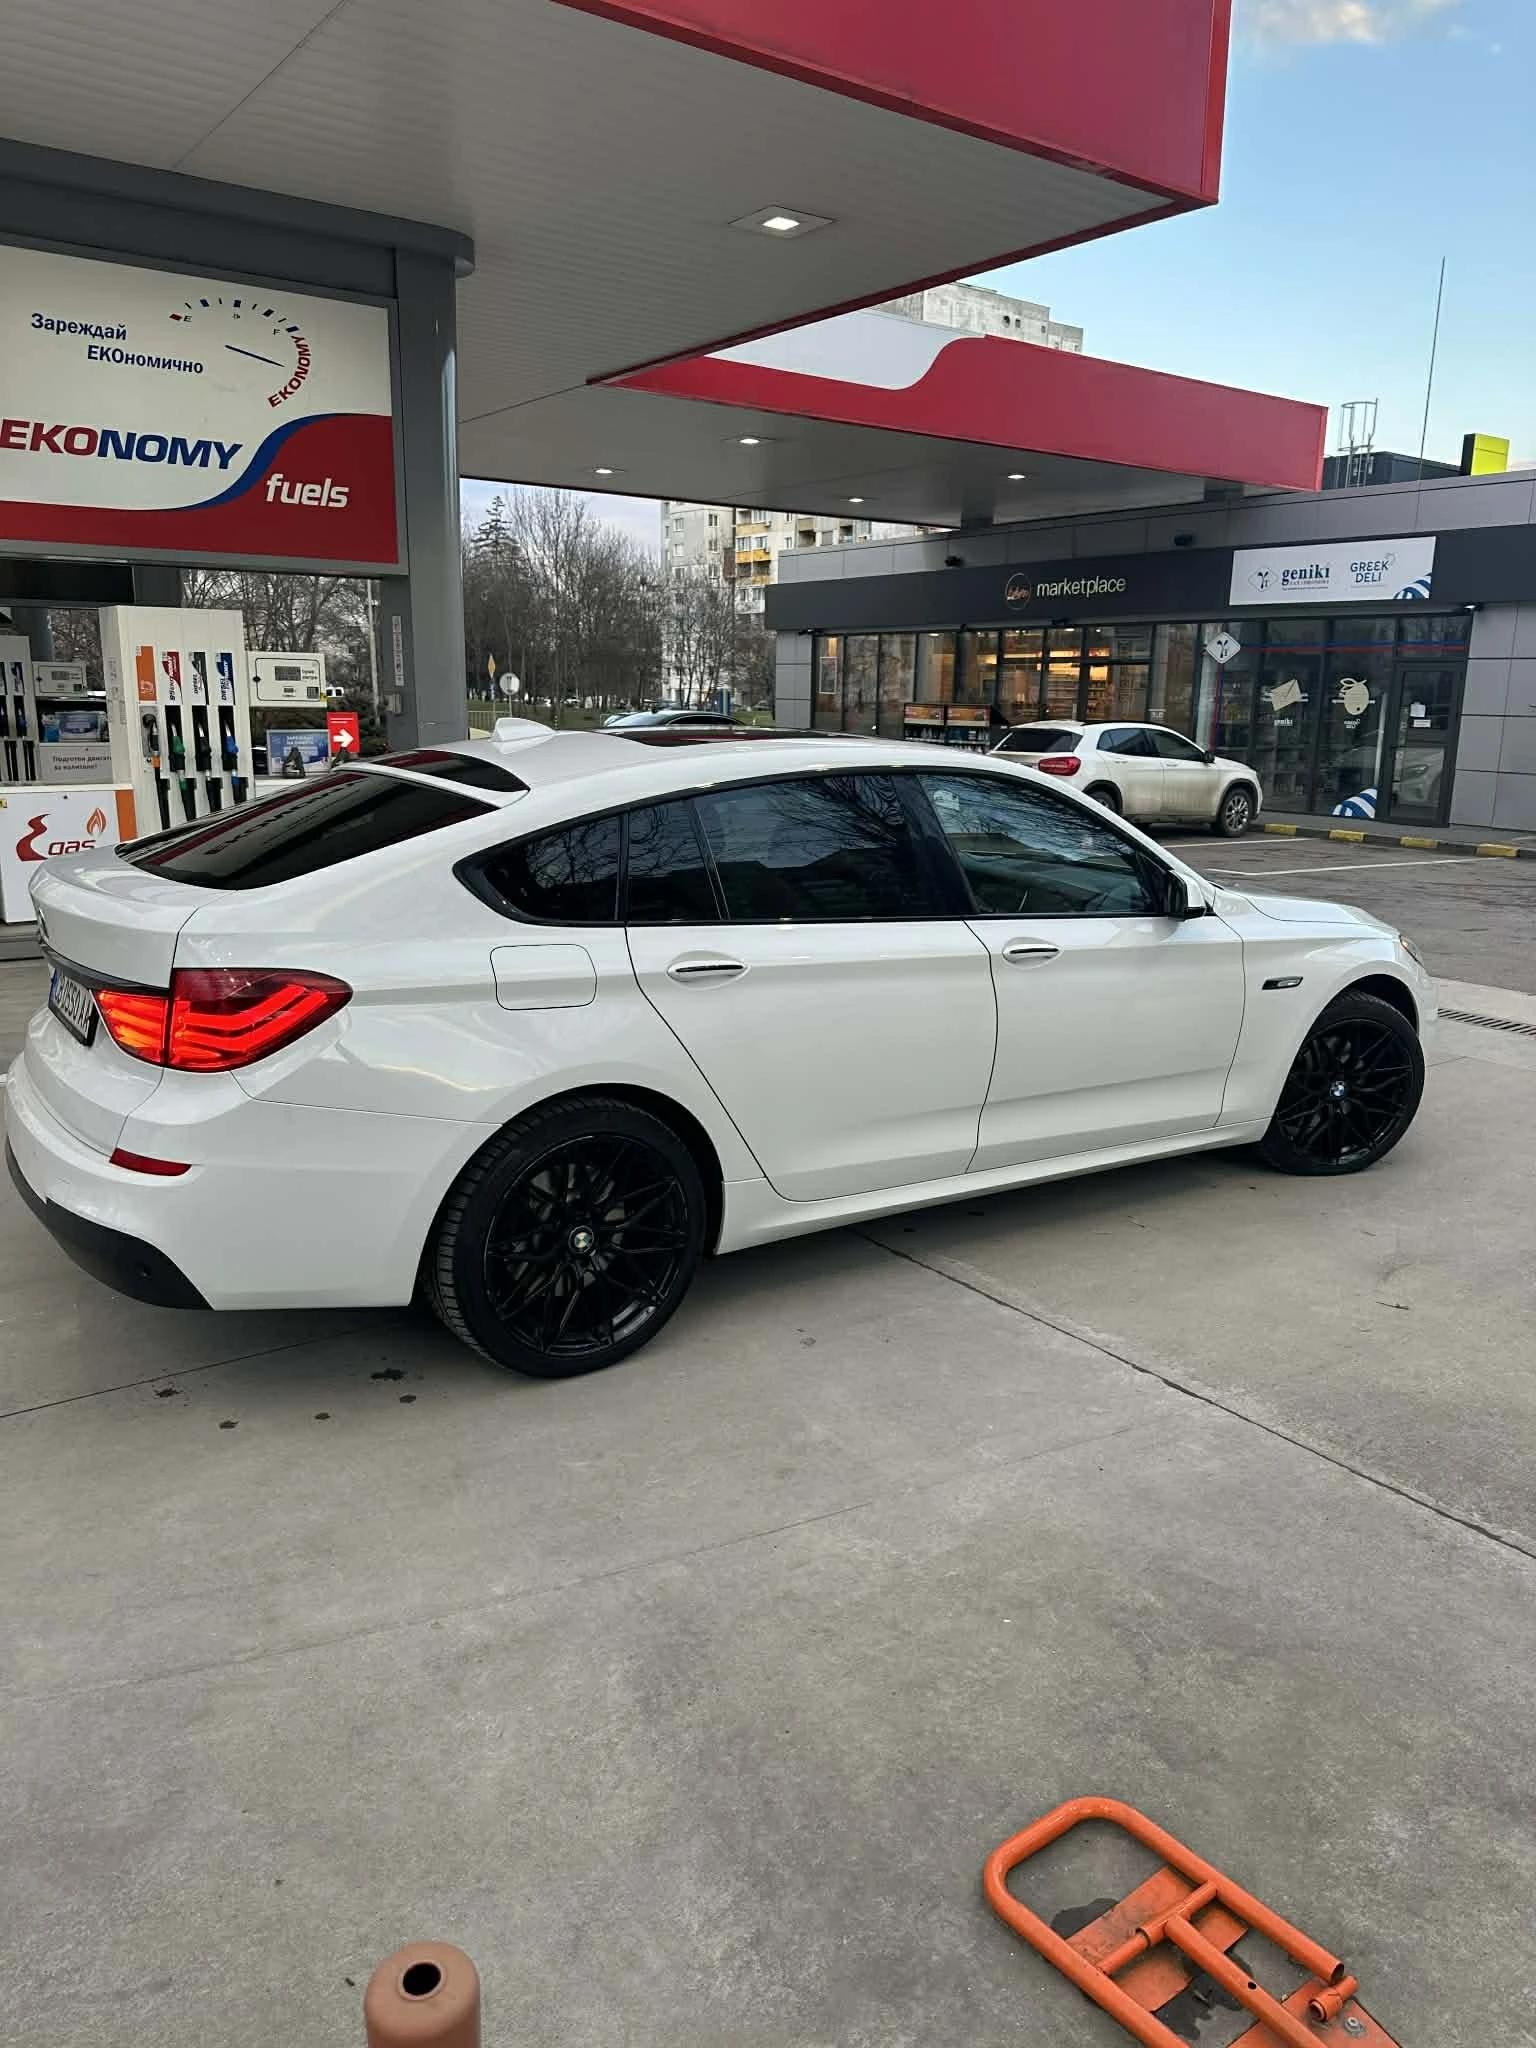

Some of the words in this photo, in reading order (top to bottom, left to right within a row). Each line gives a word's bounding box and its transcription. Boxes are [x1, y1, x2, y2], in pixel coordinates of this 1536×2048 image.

[31, 312, 128, 341] Зареждай
[267, 335, 312, 408] EKONOMY
[0, 418, 242, 470] EKONOMY
[265, 472, 350, 509] fuels
[1281, 564, 1330, 586] geniki
[1350, 560, 1390, 573] GREEK
[1355, 572, 1382, 583] DELI
[1036, 575, 1127, 598] marketplace
